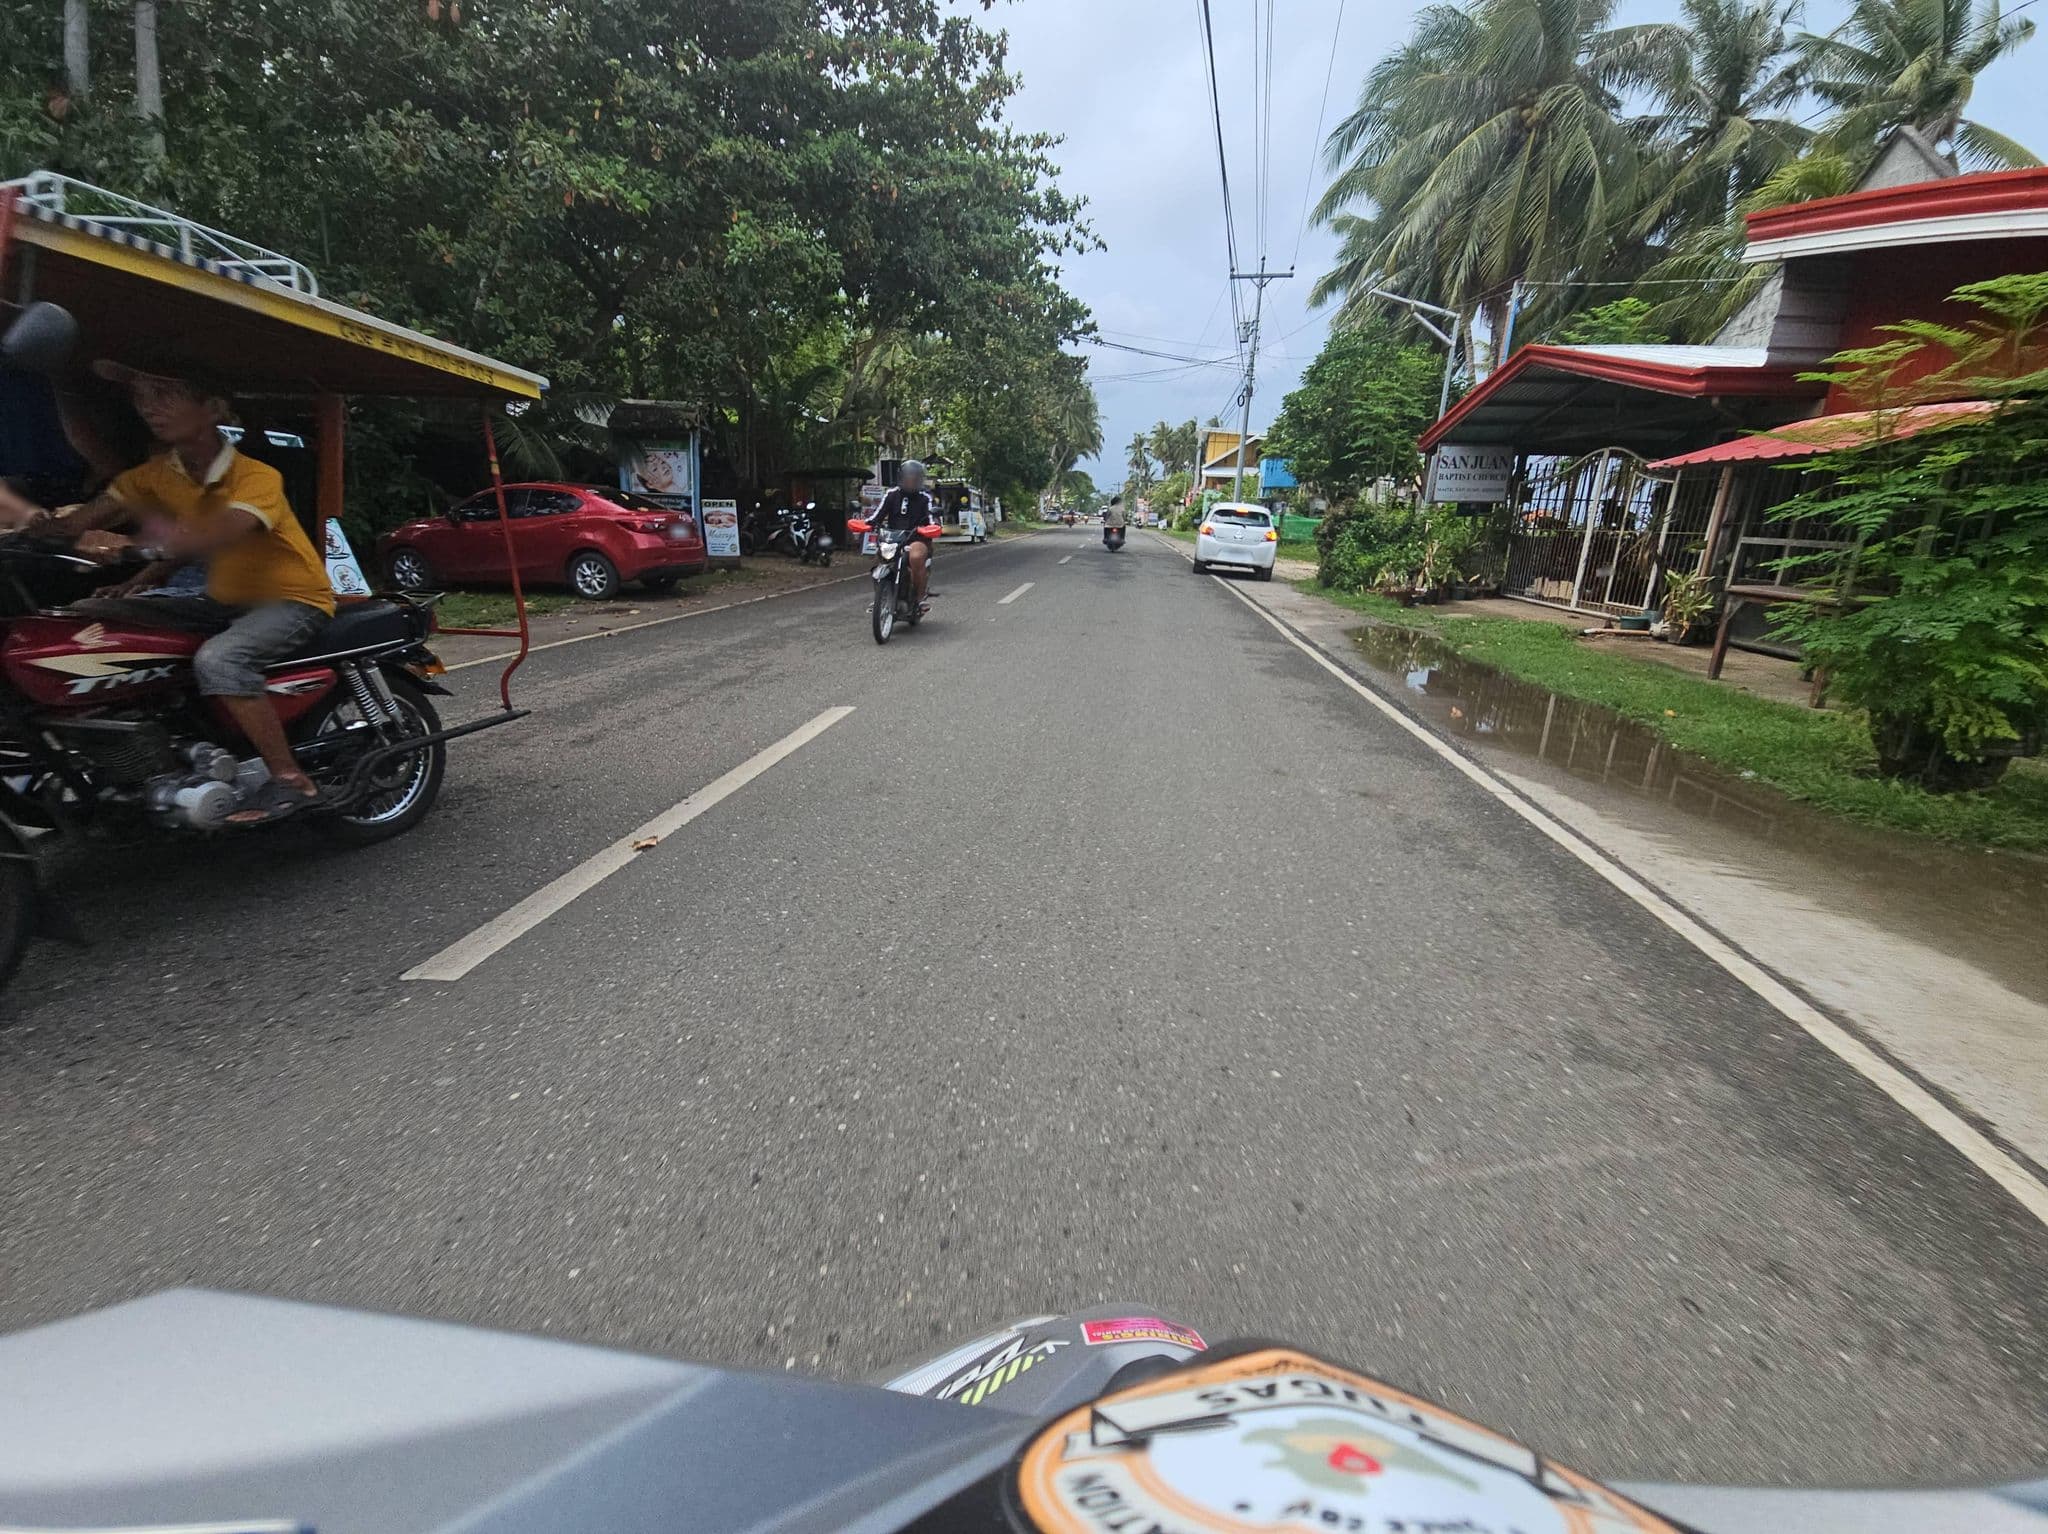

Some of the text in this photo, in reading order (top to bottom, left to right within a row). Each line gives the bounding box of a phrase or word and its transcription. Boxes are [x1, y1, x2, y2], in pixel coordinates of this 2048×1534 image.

[1440, 455, 1508, 469] SAN JUAN
[1439, 473, 1507, 481] BAPTIST CHURCH
[63, 663, 177, 695] TMX
